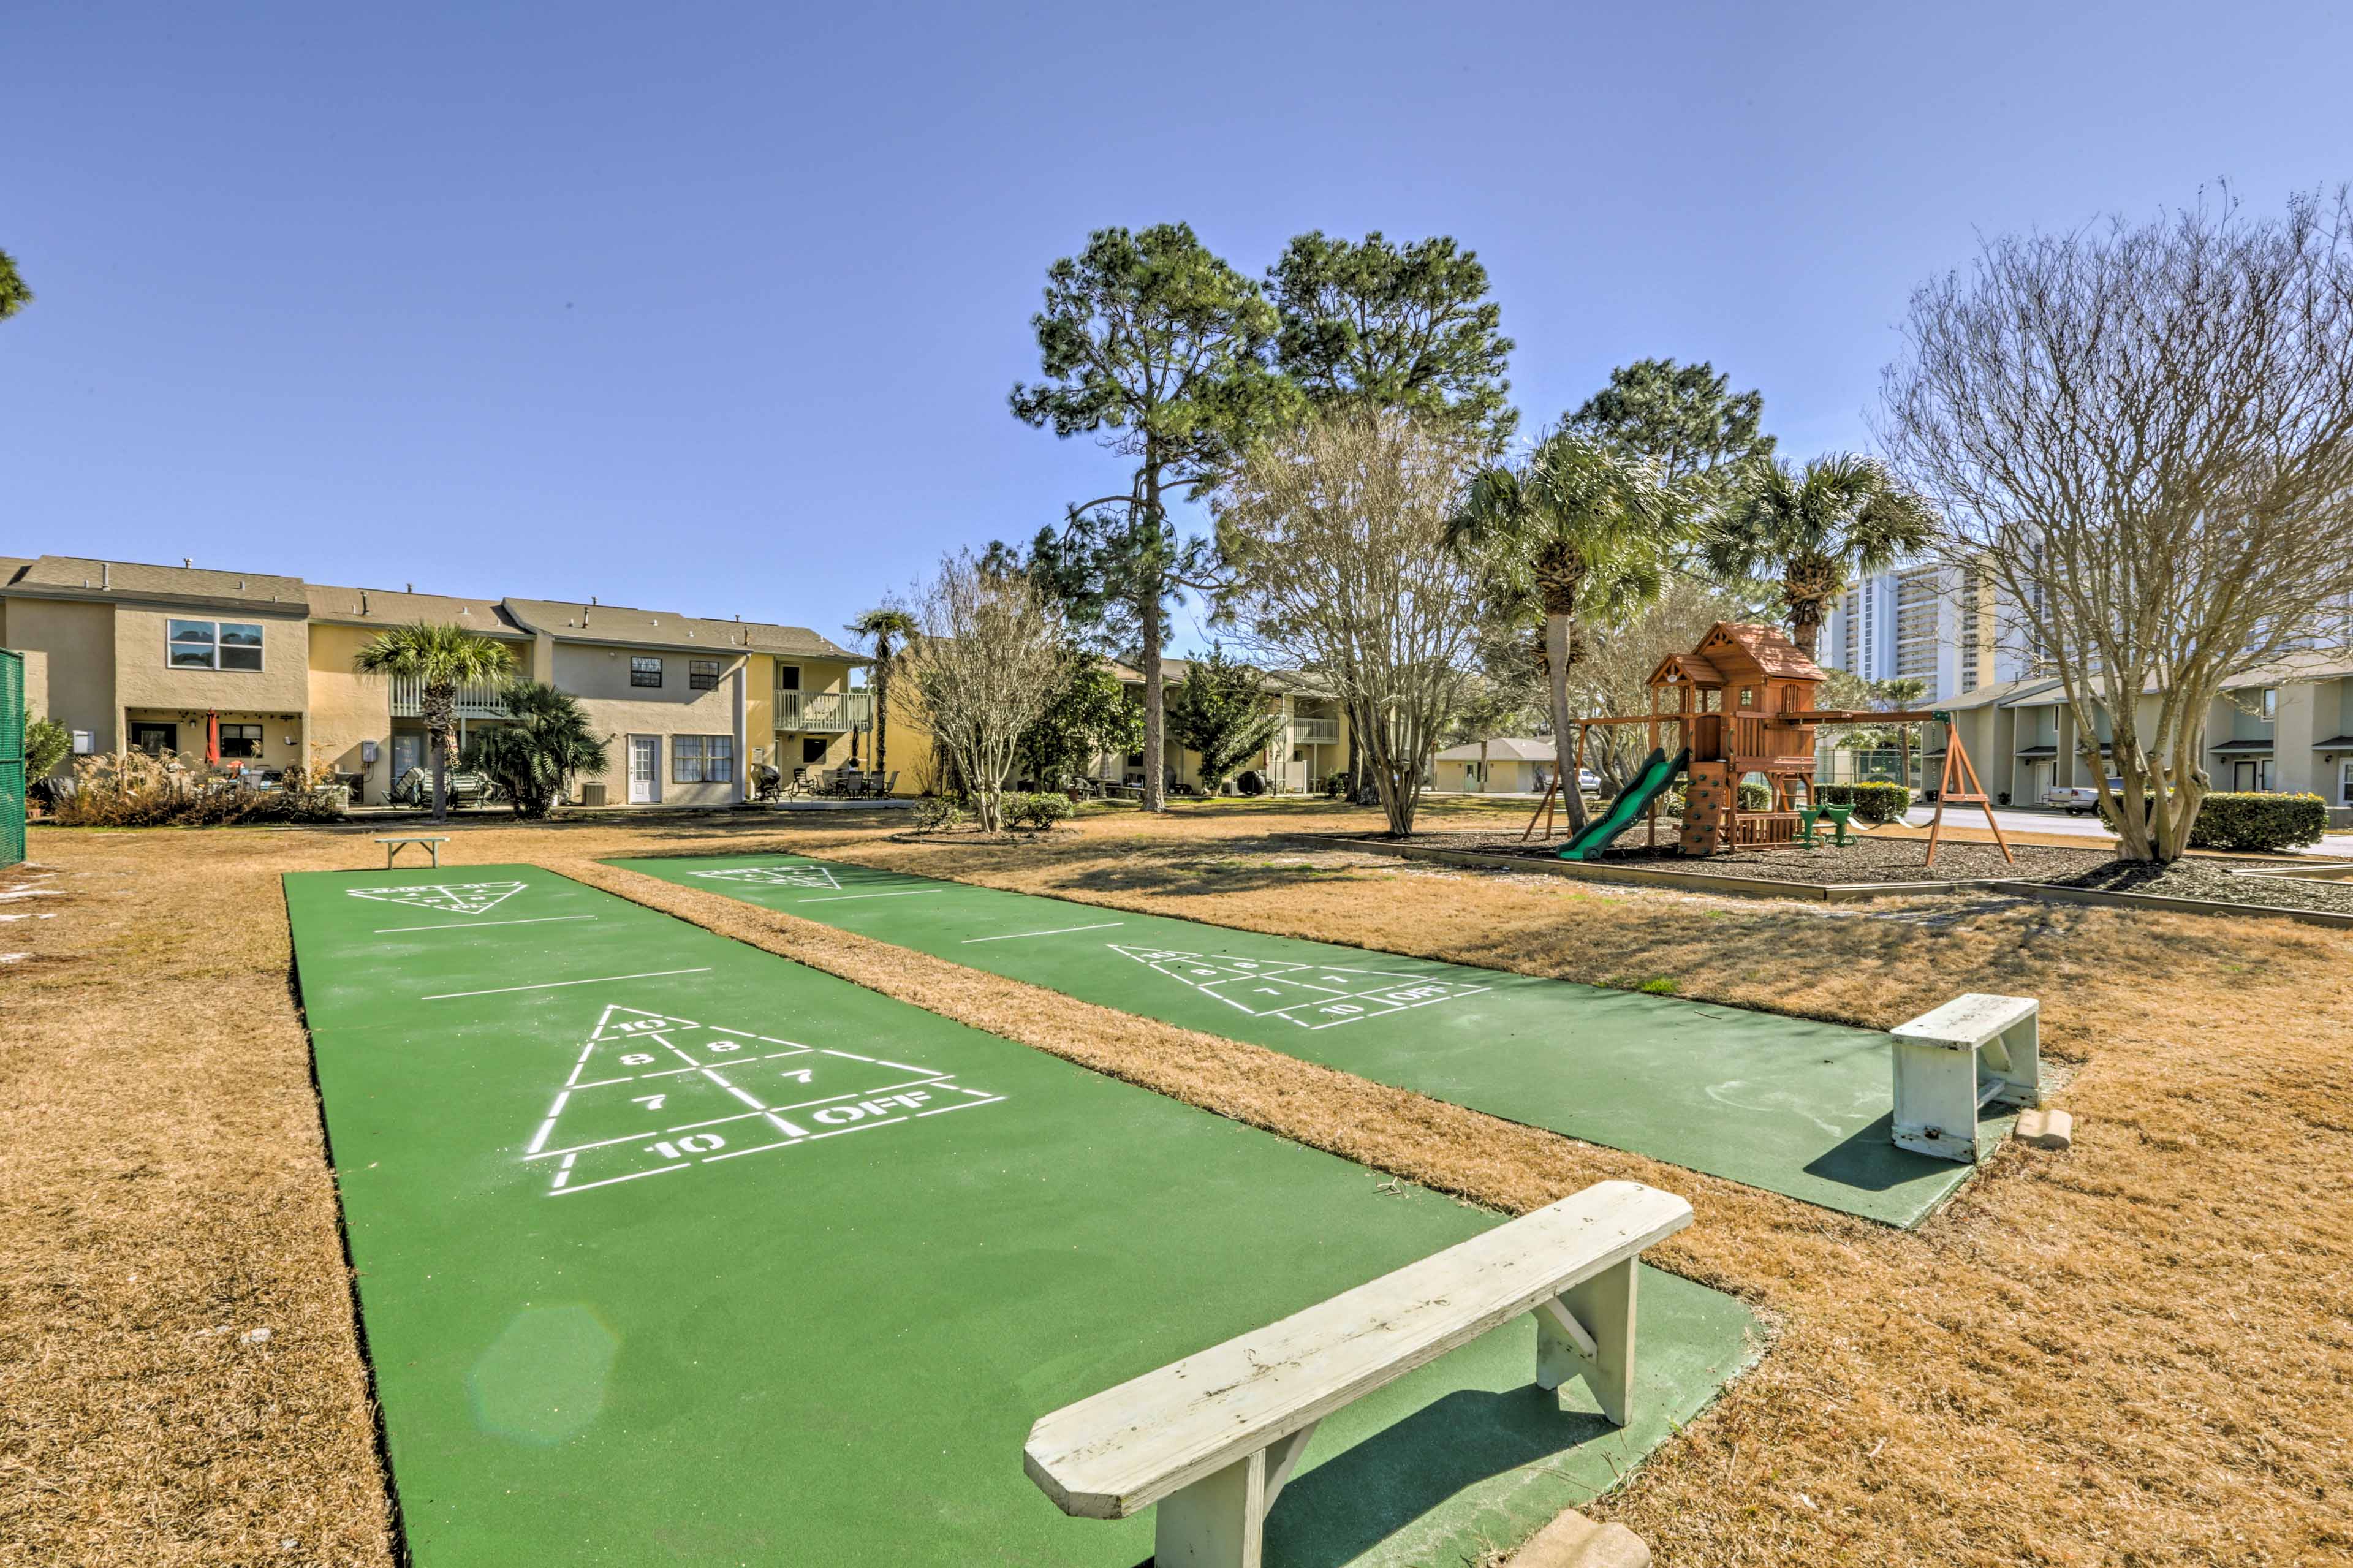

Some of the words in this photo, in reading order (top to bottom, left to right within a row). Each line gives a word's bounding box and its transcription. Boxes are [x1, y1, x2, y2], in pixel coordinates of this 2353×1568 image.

[1319, 1004, 1365, 1015] 10
[1386, 985, 1447, 1001] OFF
[611, 1019, 667, 1032] 10
[707, 1040, 741, 1052] 8
[619, 1053, 656, 1066] 8
[781, 1069, 812, 1083] 7
[631, 1094, 667, 1110] 7
[643, 1134, 726, 1159] 10
[813, 1091, 932, 1124] OFF
